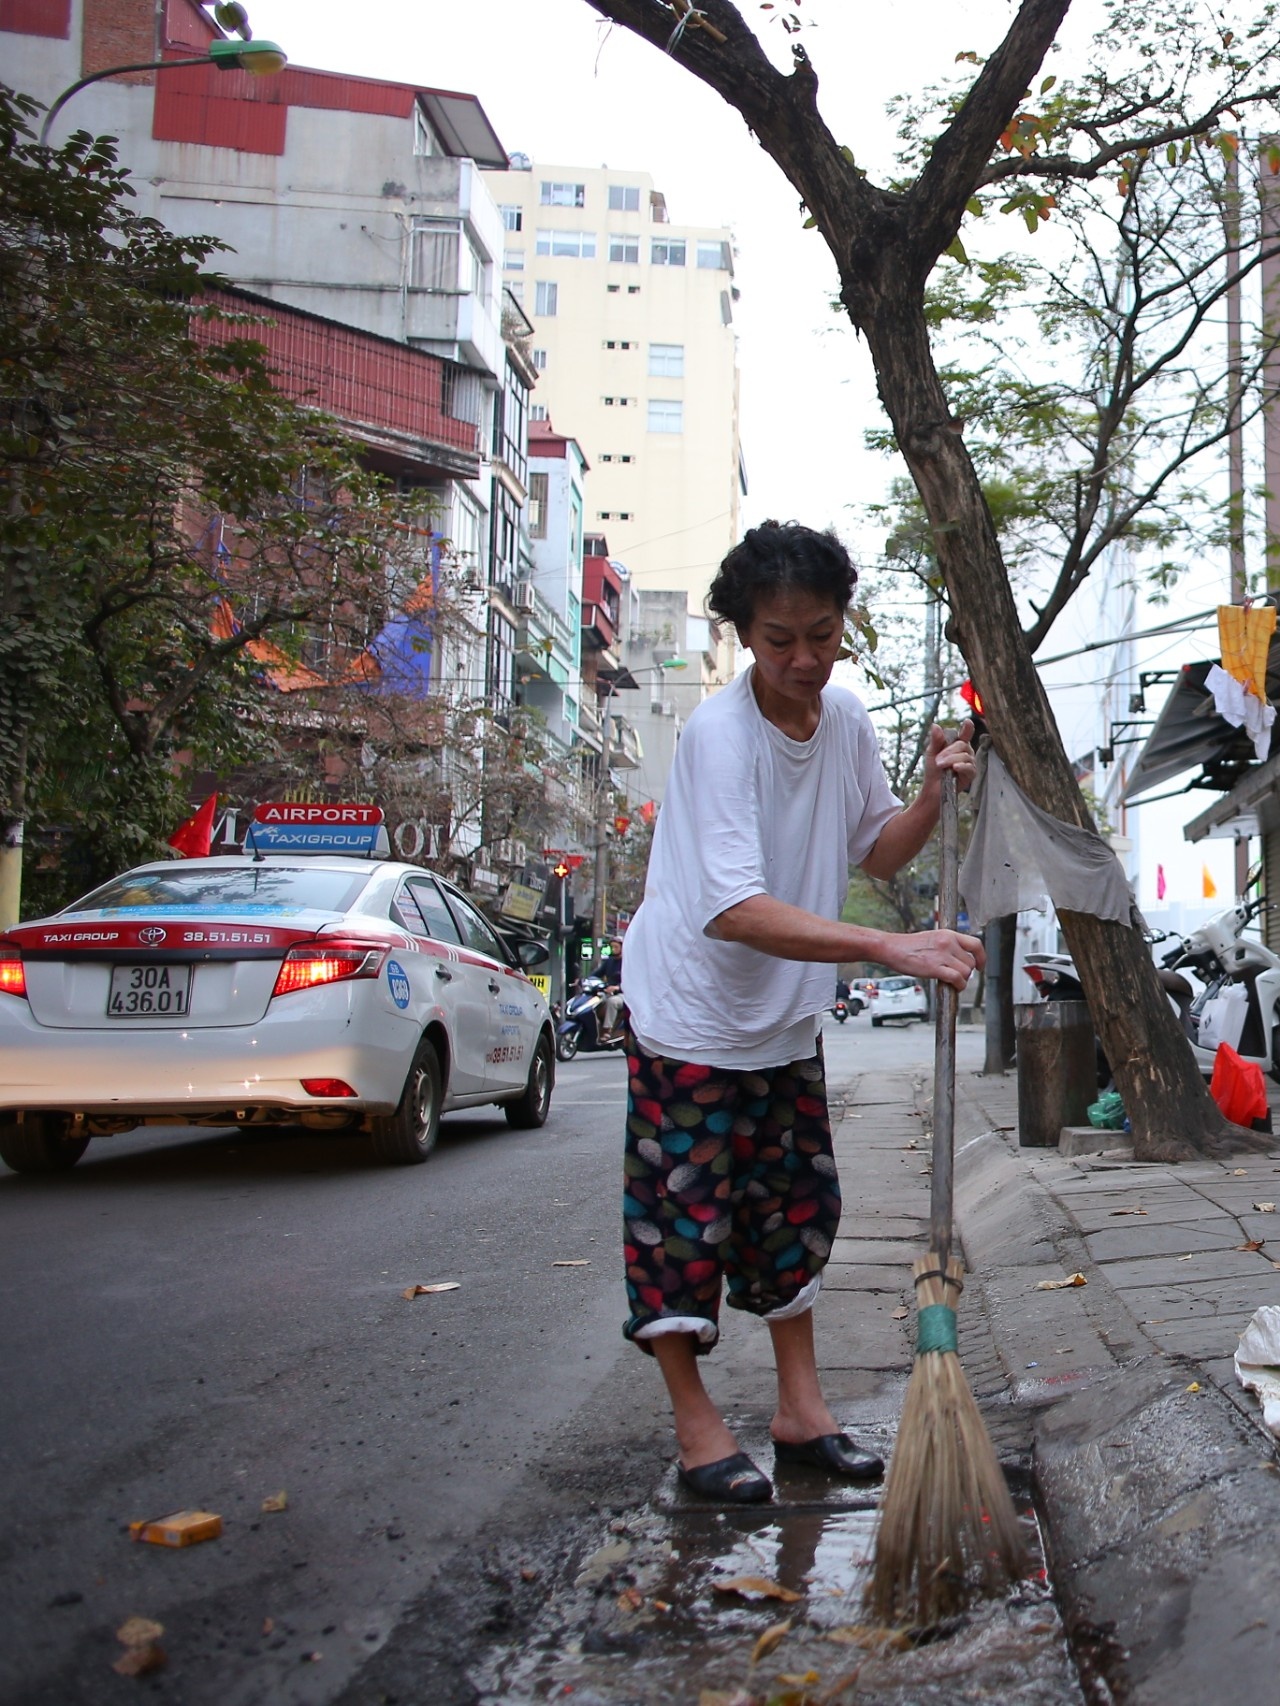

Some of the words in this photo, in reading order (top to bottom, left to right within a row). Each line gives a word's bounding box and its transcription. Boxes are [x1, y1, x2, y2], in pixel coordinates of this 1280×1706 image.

[265, 808, 373, 822] AIRPORT
[268, 834, 373, 846] TAXIGROUP
[43, 933, 73, 943] TAXI
[74, 932, 119, 942] GROUP
[183, 931, 272, 944] 38.51.51.51
[130, 967, 171, 989] 30A
[110, 991, 185, 1013] 436.01
